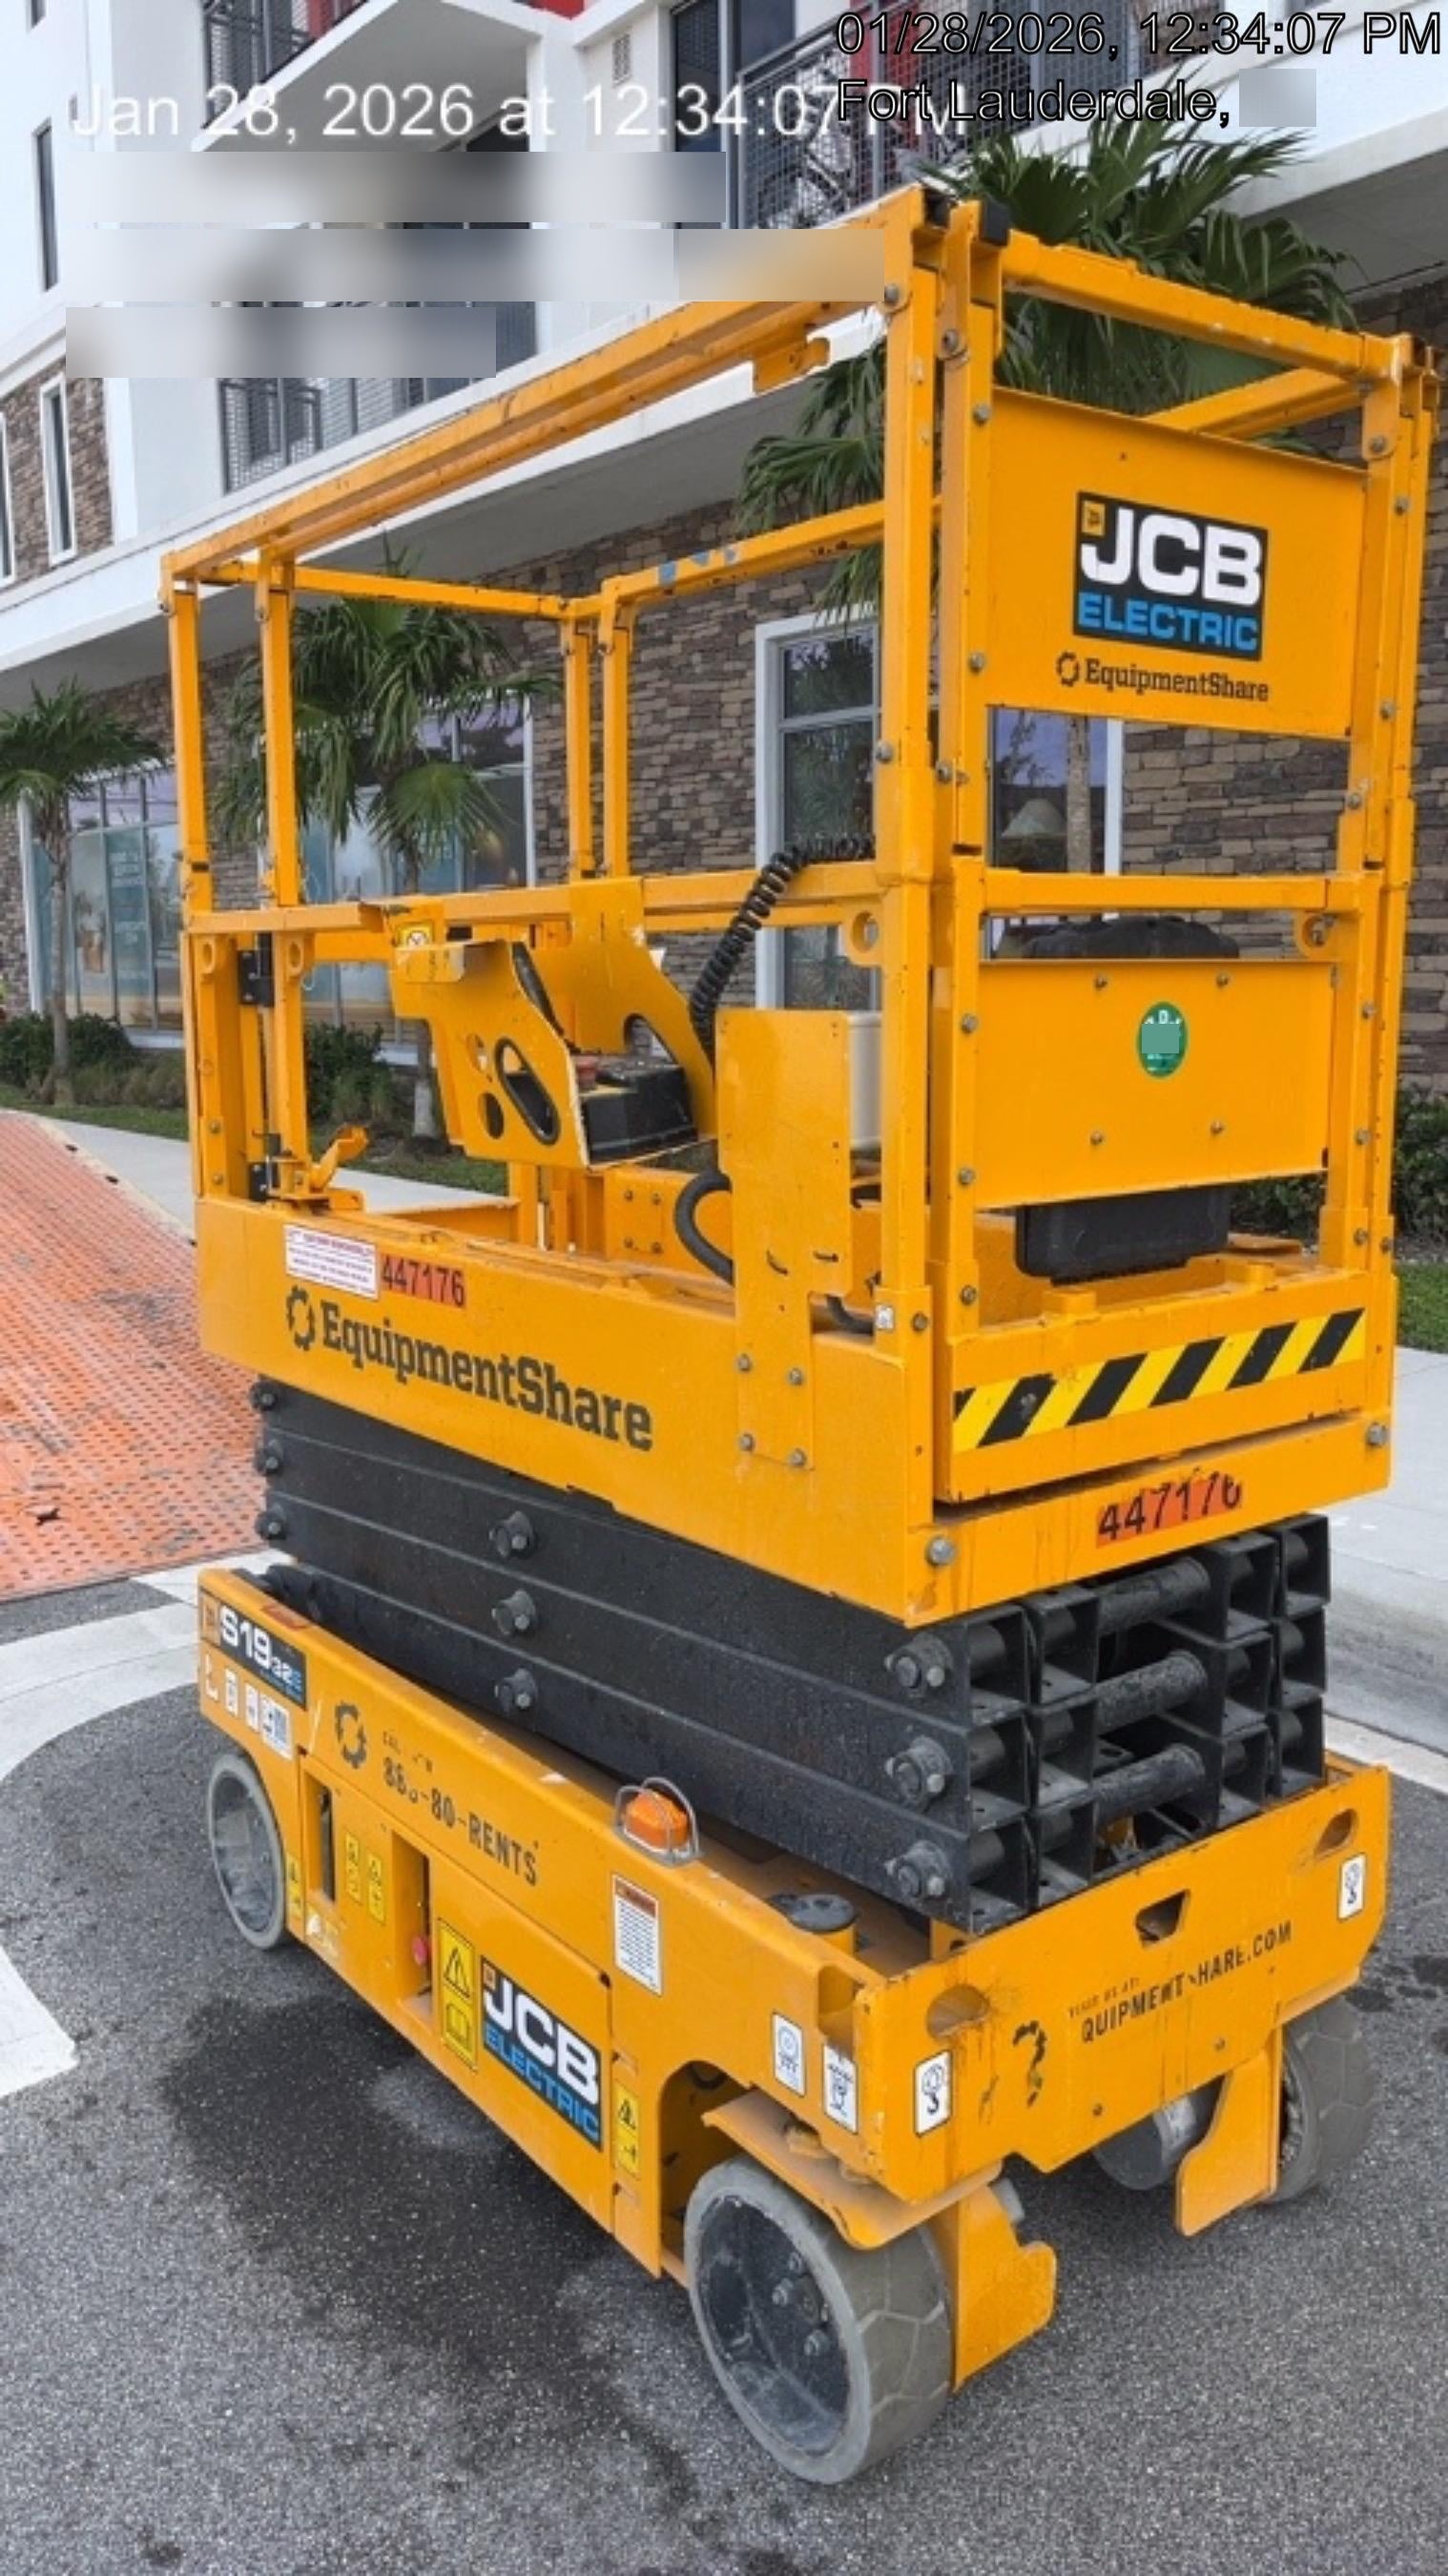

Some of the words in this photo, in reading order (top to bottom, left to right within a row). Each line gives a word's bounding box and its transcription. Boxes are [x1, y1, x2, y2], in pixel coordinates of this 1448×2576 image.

[1080, 507, 1263, 607] JCB
[1077, 591, 1259, 652] ELECTRIC
[1084, 656, 1270, 703] EquipmentShare
[381, 1252, 466, 1308] 447176
[320, 1299, 653, 1452] EquipmentShare
[483, 1976, 600, 2106] JCB
[484, 2021, 600, 2143] ELECTRIC
